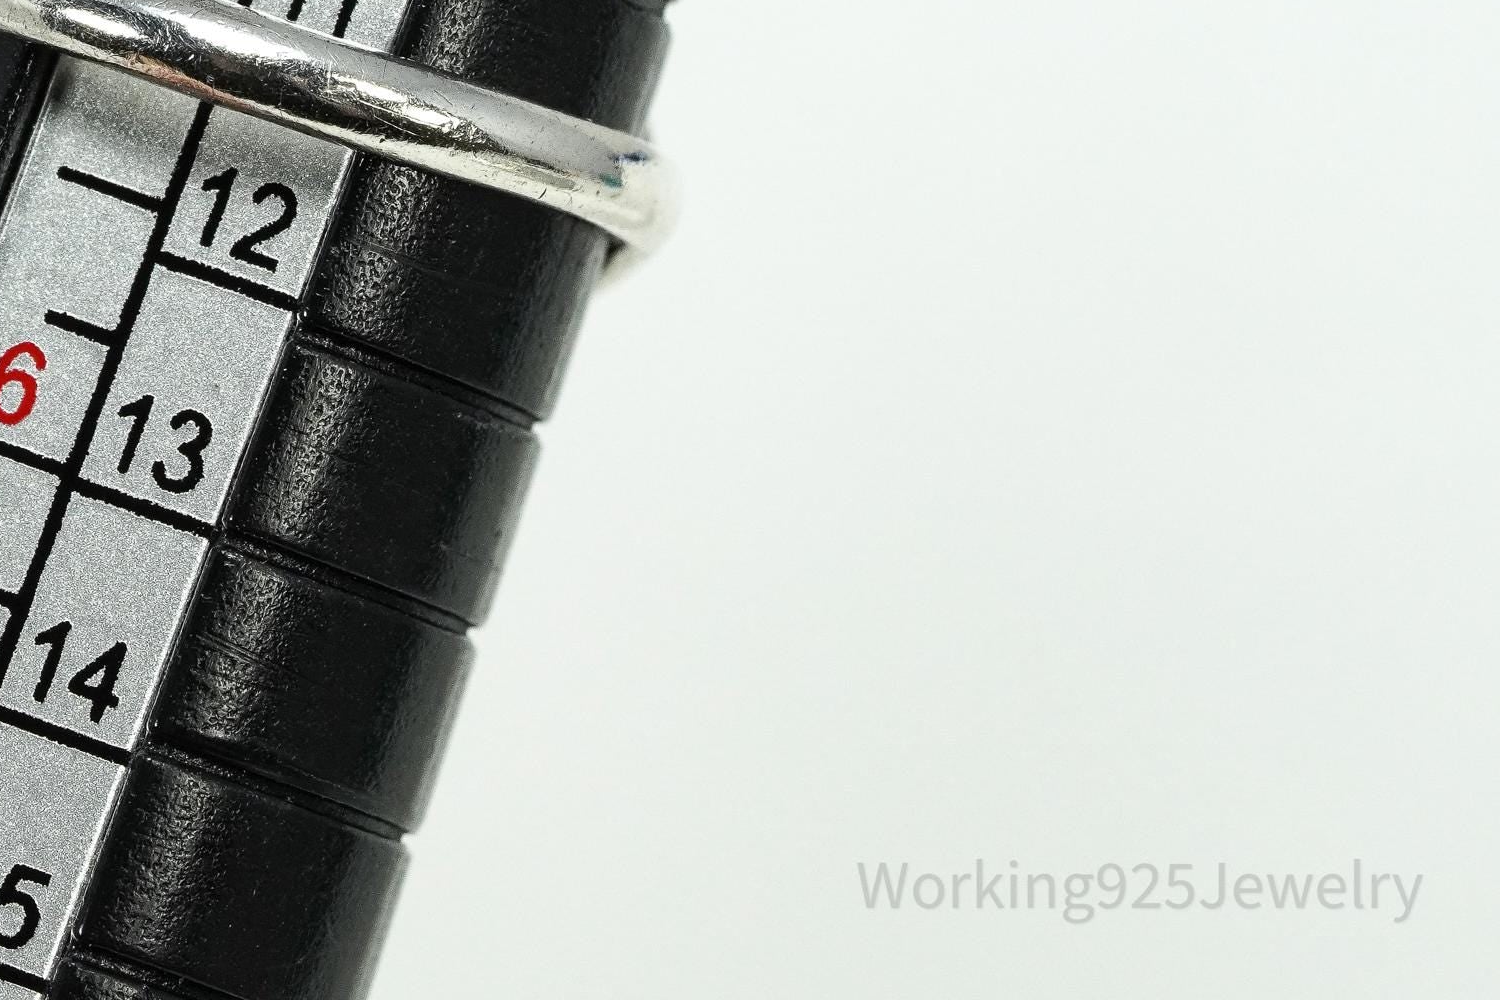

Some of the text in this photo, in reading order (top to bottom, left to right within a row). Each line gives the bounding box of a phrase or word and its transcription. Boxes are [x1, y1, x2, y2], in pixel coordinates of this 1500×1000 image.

[198, 167, 299, 272] 12
[116, 394, 214, 495] 13
[32, 620, 128, 725] 14
